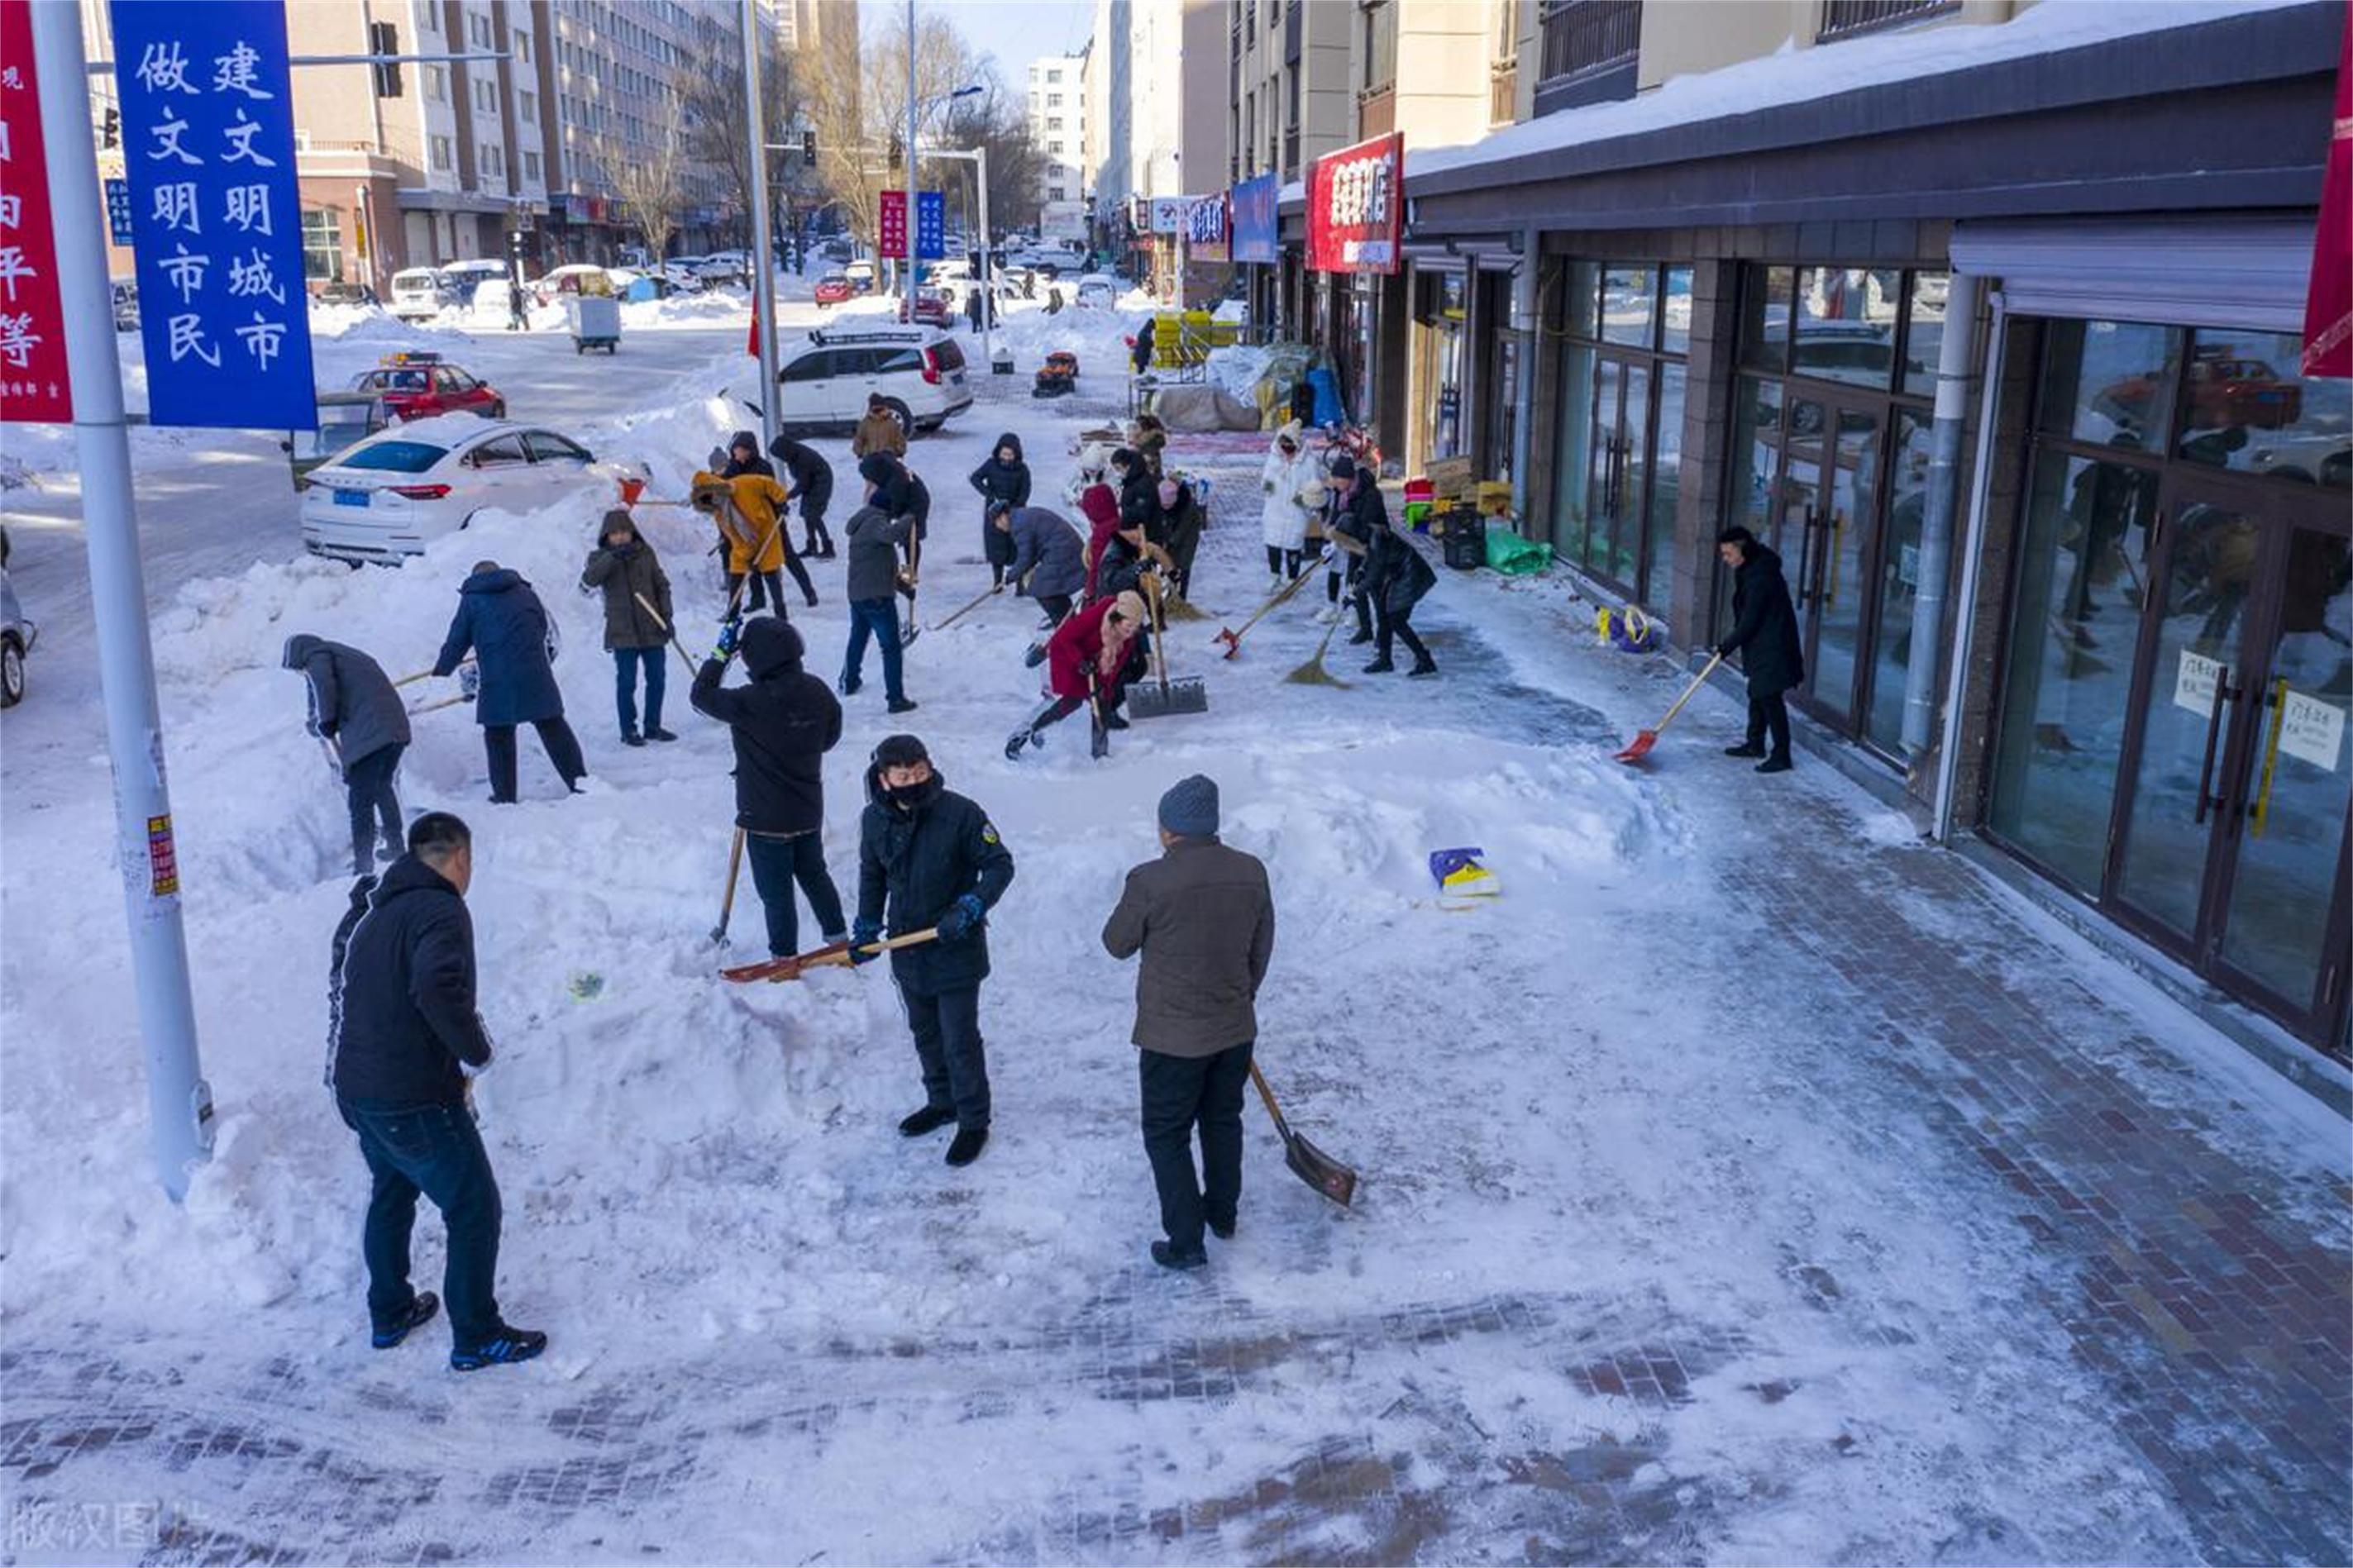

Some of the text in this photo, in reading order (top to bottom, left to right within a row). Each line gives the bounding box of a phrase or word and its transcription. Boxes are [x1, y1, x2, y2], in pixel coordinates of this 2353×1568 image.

[0, 120, 42, 369] 平等
[136, 41, 221, 368] 做文明市民
[213, 41, 287, 371] 建文明城市
